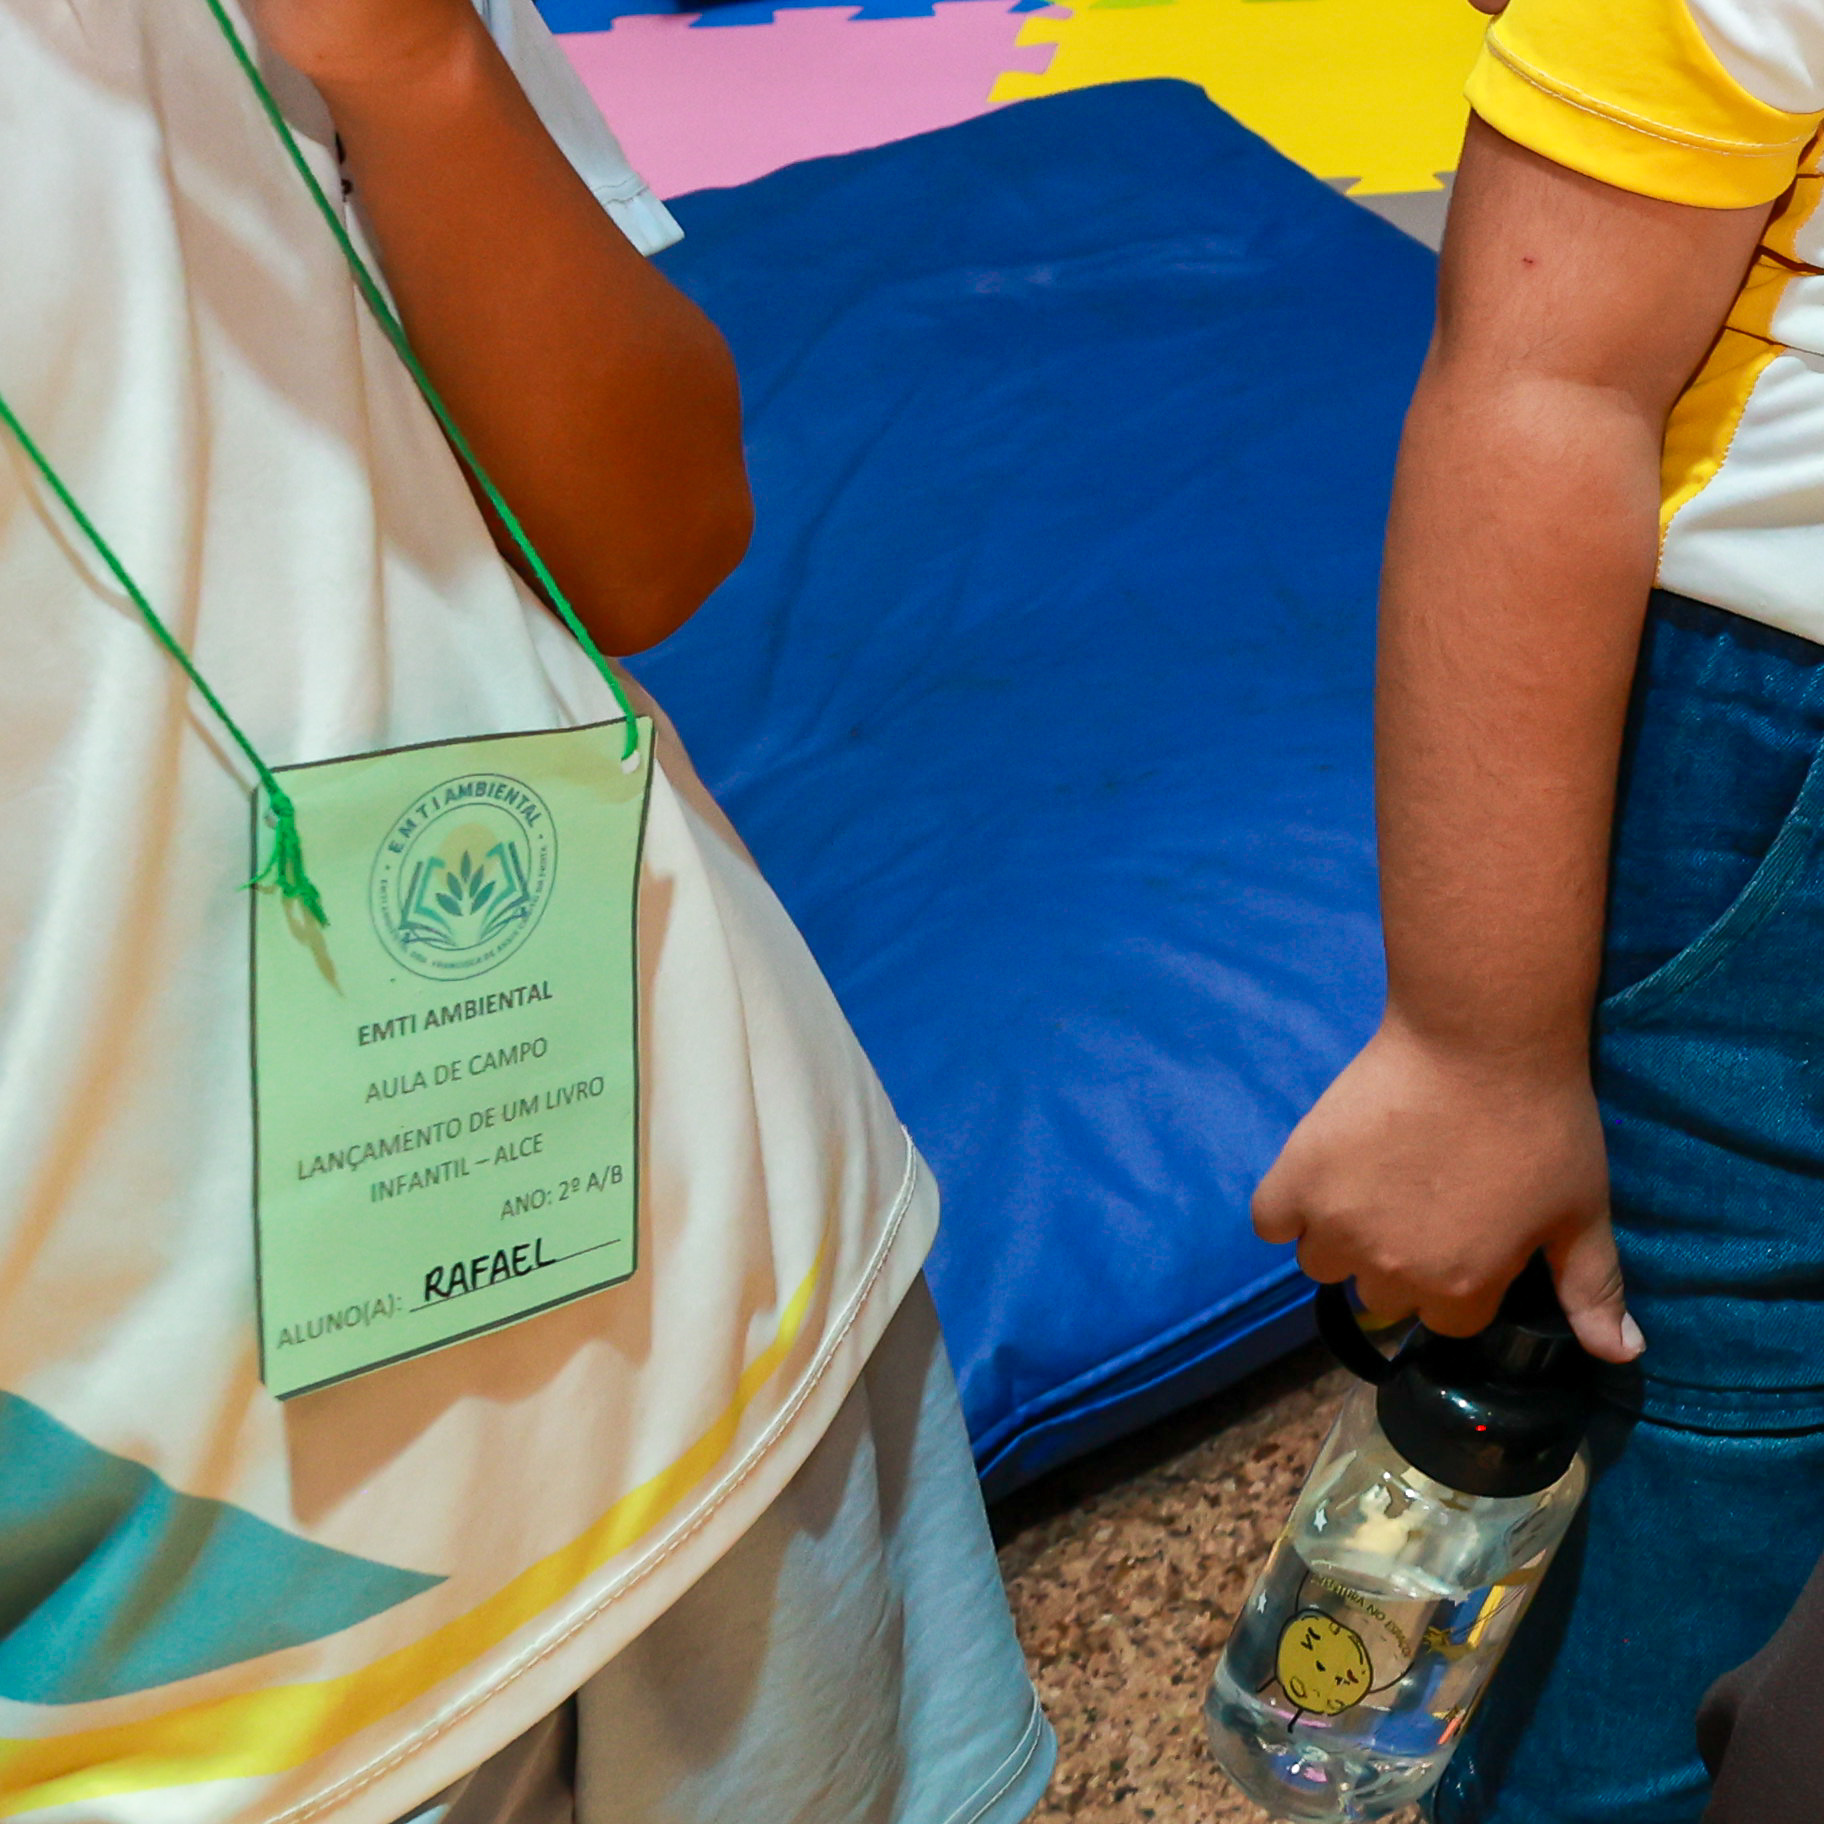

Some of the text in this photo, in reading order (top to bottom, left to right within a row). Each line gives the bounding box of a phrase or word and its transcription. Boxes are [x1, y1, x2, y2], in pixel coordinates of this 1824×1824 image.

[444, 781, 543, 828] AMBIENTAL
[358, 980, 554, 1047] EMTI AMBIENTAL
[365, 1037, 548, 1104] AULA DE CAMPO
[297, 1075, 605, 1181] LANÇAMENTO DE UM LIVRO
[371, 1156, 470, 1204] INFANTIL
[494, 1132, 544, 1167] ALCE
[500, 1164, 625, 1222] ANO: 2º A/B
[424, 1237, 557, 1302] RAFAEL
[277, 1293, 403, 1351] ALUNO(A):
